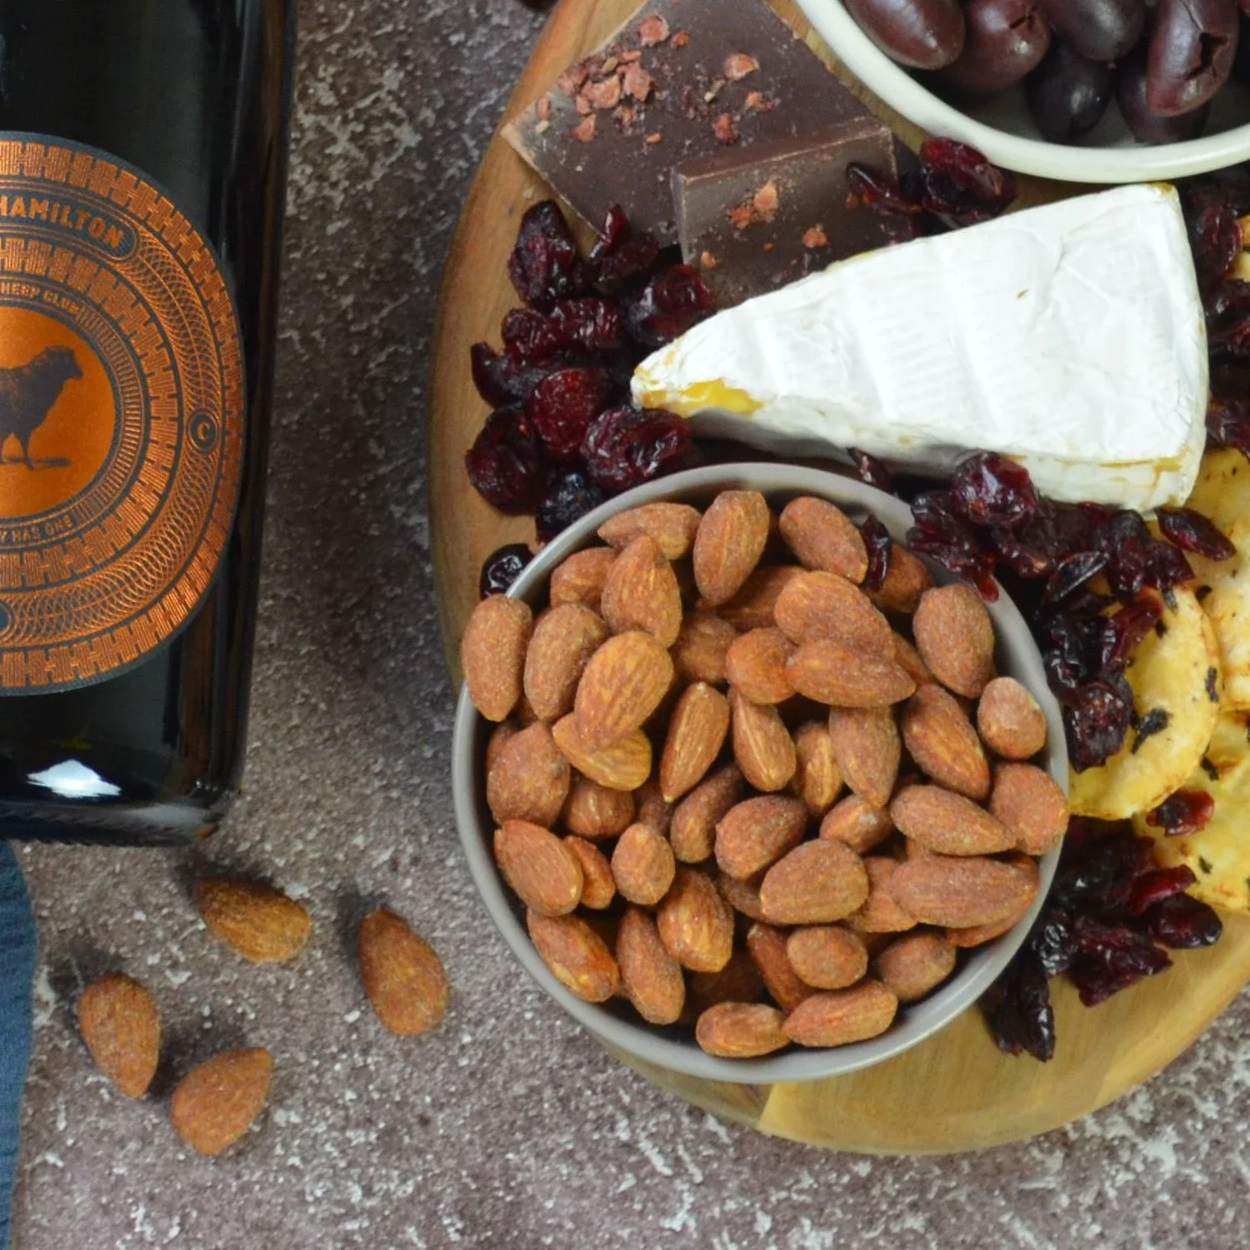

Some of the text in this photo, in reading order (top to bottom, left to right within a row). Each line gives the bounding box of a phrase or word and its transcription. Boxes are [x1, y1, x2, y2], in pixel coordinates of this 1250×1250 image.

[197, 421, 211, 441] C
[11, 525, 41, 543] HAS
[45, 515, 74, 535] ONE
